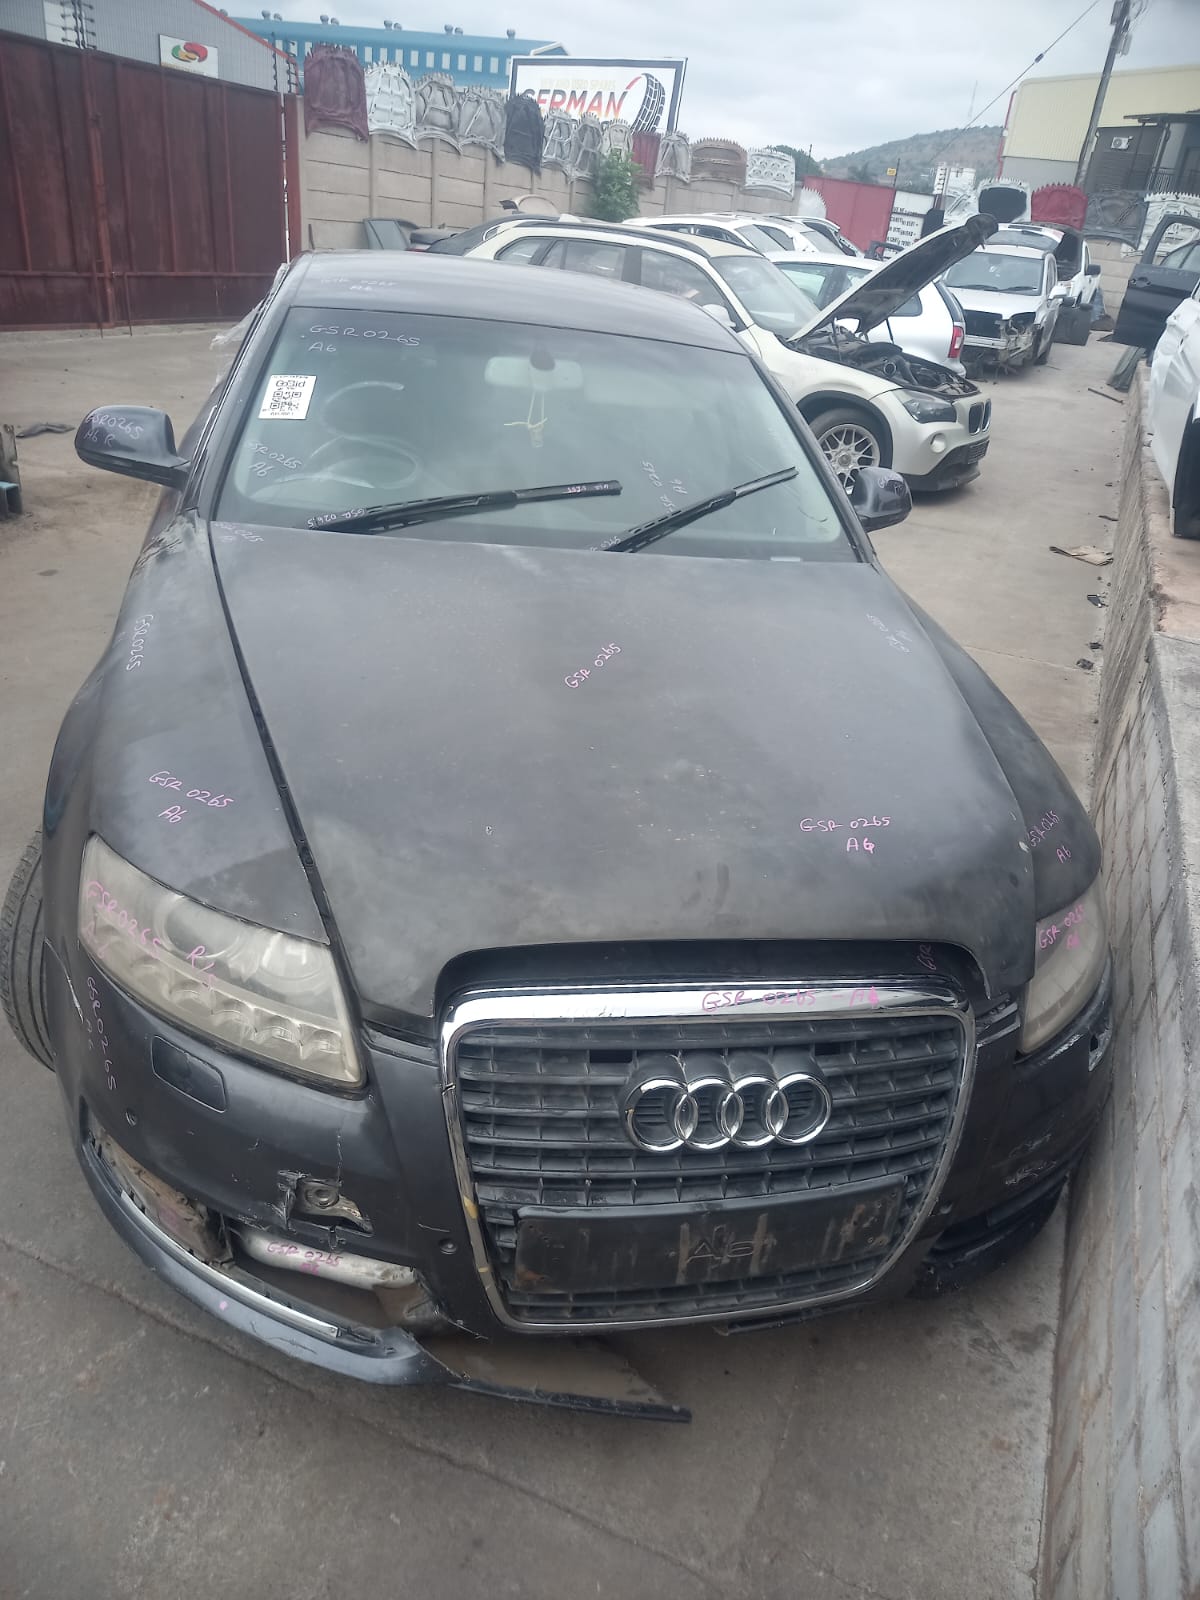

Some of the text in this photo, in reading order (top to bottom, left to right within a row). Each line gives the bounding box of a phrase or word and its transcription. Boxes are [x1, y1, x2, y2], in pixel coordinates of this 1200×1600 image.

[308, 341, 337, 352] A6
[564, 642, 622, 688] GSR 0265
[148, 770, 235, 808] GSR 0265
[158, 804, 189, 823] A6
[799, 815, 891, 832] GSR 0265
[1039, 925, 1060, 949] GSR
[702, 990, 752, 1012] GSR
[304, 1250, 344, 1267] 0265
